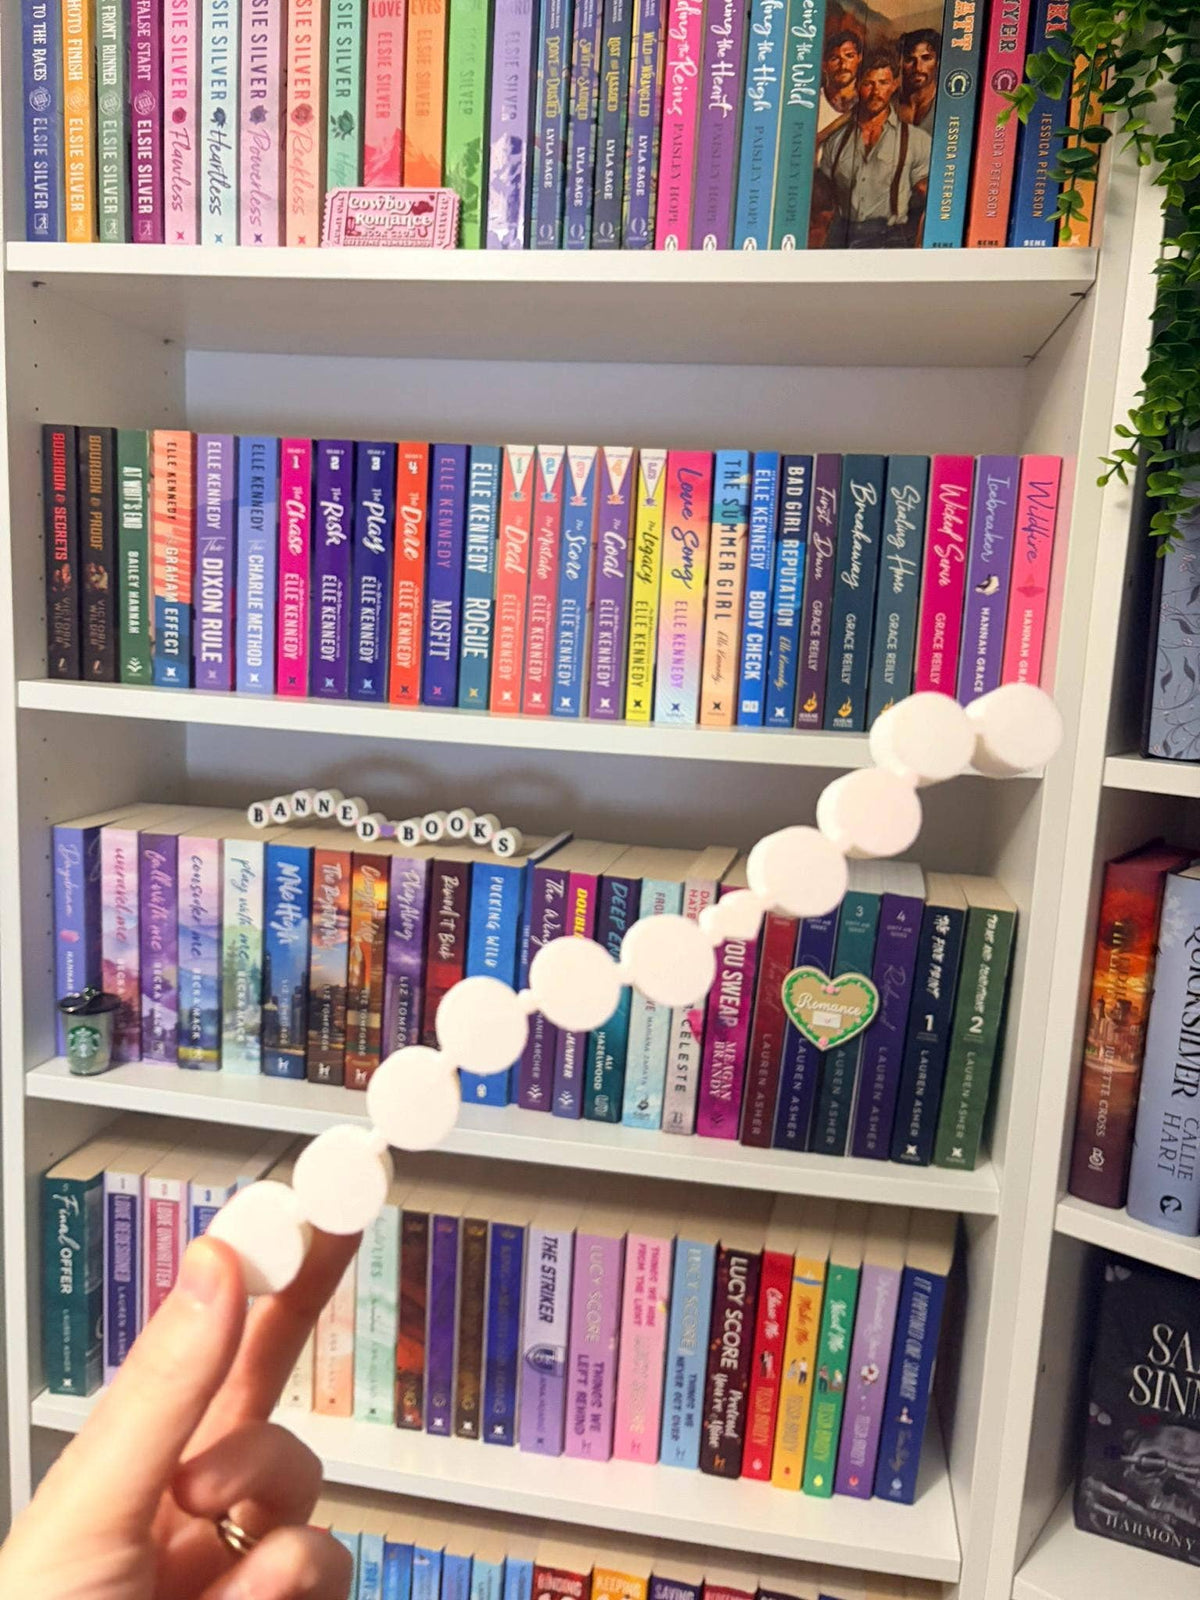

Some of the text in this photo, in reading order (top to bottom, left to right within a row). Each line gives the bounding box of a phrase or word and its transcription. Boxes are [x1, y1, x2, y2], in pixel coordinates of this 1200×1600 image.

[32, 4, 46, 81] TO THE RACES
[103, 5, 117, 85] FRONT RUNNER
[136, 0, 152, 81] FALSE START
[249, 34, 268, 100] SILVER
[294, 34, 313, 100] SILVER
[335, 36, 352, 98] SILVER
[376, 31, 392, 119] ELSIE SILVER
[667, 58, 698, 116] Reins
[708, 61, 735, 119] Heart
[33, 117, 49, 209] ELSIE SILVER
[69, 117, 86, 211] ELSIE SILVER
[103, 120, 119, 213] ELSIE SILVER
[137, 119, 154, 214] ELSIE SILVER
[166, 129, 192, 212] Flawless
[206, 130, 233, 216] Heartless
[247, 129, 272, 226] Powerless
[939, 116, 960, 222] JESSICA PETERSON
[985, 162, 1002, 219] PETERSON
[1031, 113, 1053, 218] JESSICA PETERSON
[166, 442, 177, 521] ELLE KENNEDY
[206, 441, 221, 529] ELLE KENNEDY
[250, 444, 265, 532] ELLE KENNEDY
[437, 457, 456, 569] ELLE KENNEDY
[468, 462, 492, 573] ELLE KENNEDY
[750, 469, 770, 570] ELLE KENNEDY
[979, 474, 1010, 563] Icebreaker
[1021, 481, 1054, 563] Wildfire
[503, 524, 528, 575] Deal
[536, 529, 553, 580] Mistake
[564, 530, 586, 581] Score
[601, 530, 627, 578] Goal
[636, 531, 659, 584] Legacy
[671, 467, 703, 590] Love Song
[714, 459, 741, 620] THE SUMMER GIRL
[776, 466, 805, 627] BAD GIRL REPUTATION
[840, 480, 876, 590] Breakaway
[885, 484, 921, 595] Stealing Home
[933, 484, 968, 587] Wicked Serve
[164, 547, 179, 656] GRAHAM EFFECT
[246, 554, 264, 667] CHARLIE METHOD
[284, 572, 299, 660] ELLE KENNEDY
[321, 574, 336, 662] ELLE KENNEDY
[360, 575, 376, 663] ELLE KENNEDY
[396, 580, 414, 669] ELLE KENNEDY
[429, 598, 452, 660] MISFIT
[463, 597, 490, 659] ROGUE
[528, 594, 545, 682] ELLE KENNEDY
[557, 599, 575, 686] ELLE KENNEDY
[596, 599, 613, 687] ELLE KENNEDY
[630, 600, 647, 688] ELLE KENNEDY
[670, 600, 688, 689] ELLE KENNEDY
[744, 590, 765, 681] BODY CHECK
[806, 600, 823, 671] GRACE REILLY
[840, 613, 857, 684] GRACE REILLY
[883, 613, 900, 684] GRACE REILLY
[929, 612, 947, 684] GRACE REILLY
[973, 607, 990, 692] HANNAH GRACE
[253, 797, 509, 853] BANNED BOOKS
[114, 847, 133, 943] unravel me
[268, 903, 300, 946] High
[276, 862, 303, 902] Mile
[484, 876, 504, 968] PUCKING WILD
[544, 878, 565, 903] The
[609, 881, 629, 930] DEEP
[190, 931, 202, 957] me
[717, 938, 745, 1028] YOU SWEAR
[795, 992, 862, 1016] Romance
[532, 1042, 544, 1078] ARCHER
[561, 1032, 576, 1078] JUNIPER
[592, 1031, 605, 1091] HAZELWOOD
[674, 1018, 692, 1093] CELESTE
[708, 1040, 725, 1098] BRANDY
[719, 1040, 737, 1100] MEAGAN
[752, 1033, 771, 1134] LAUREN ASHER
[786, 1038, 806, 1139] LAUREN ASHER
[866, 1046, 888, 1150] LAUREN ASHER
[909, 1049, 930, 1137] LAUREN ASHER
[955, 1051, 976, 1139] LAUREN ASHER
[1094, 1045, 1115, 1138] JULIETTE CROSS
[826, 1100, 841, 1144] ASHER
[1156, 1111, 1182, 1177] HART
[1176, 1116, 1200, 1182] CALLIE
[52, 1194, 81, 1294] Final OFFER
[538, 1235, 558, 1324] THE STRIKER
[584, 1244, 604, 1345] LUCY SCORE
[680, 1248, 701, 1349] LUCY SCORE
[720, 1256, 749, 1370] LUCY SCORE
[574, 1354, 590, 1436] LEFT BEHIND
[588, 1361, 605, 1433] THINGS WE
[724, 1389, 743, 1439] Pretend
[1105, 1514, 1197, 1552] HARMONY
